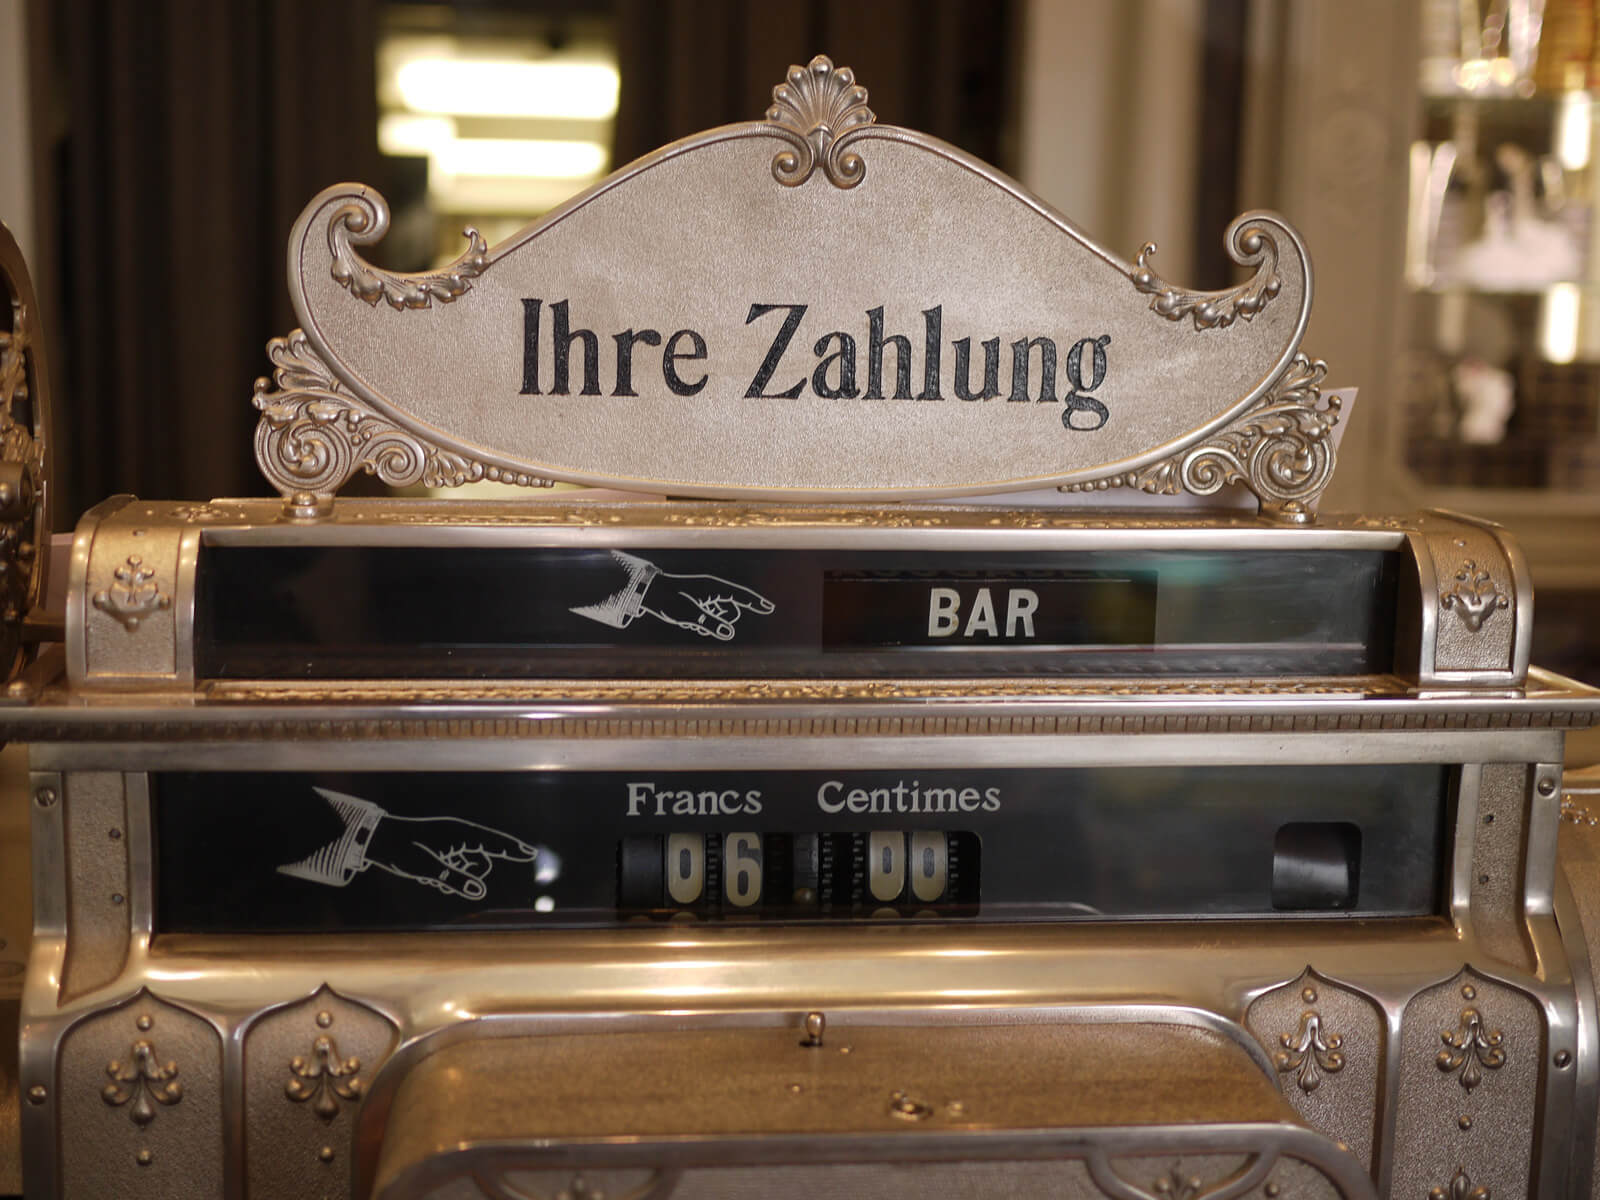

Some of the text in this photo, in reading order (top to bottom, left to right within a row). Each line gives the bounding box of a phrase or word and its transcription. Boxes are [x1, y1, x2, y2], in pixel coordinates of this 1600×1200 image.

[518, 297, 1111, 431] Ihre Zahlung
[927, 587, 1040, 638] BAR
[626, 780, 1001, 816] Francs Centimes
